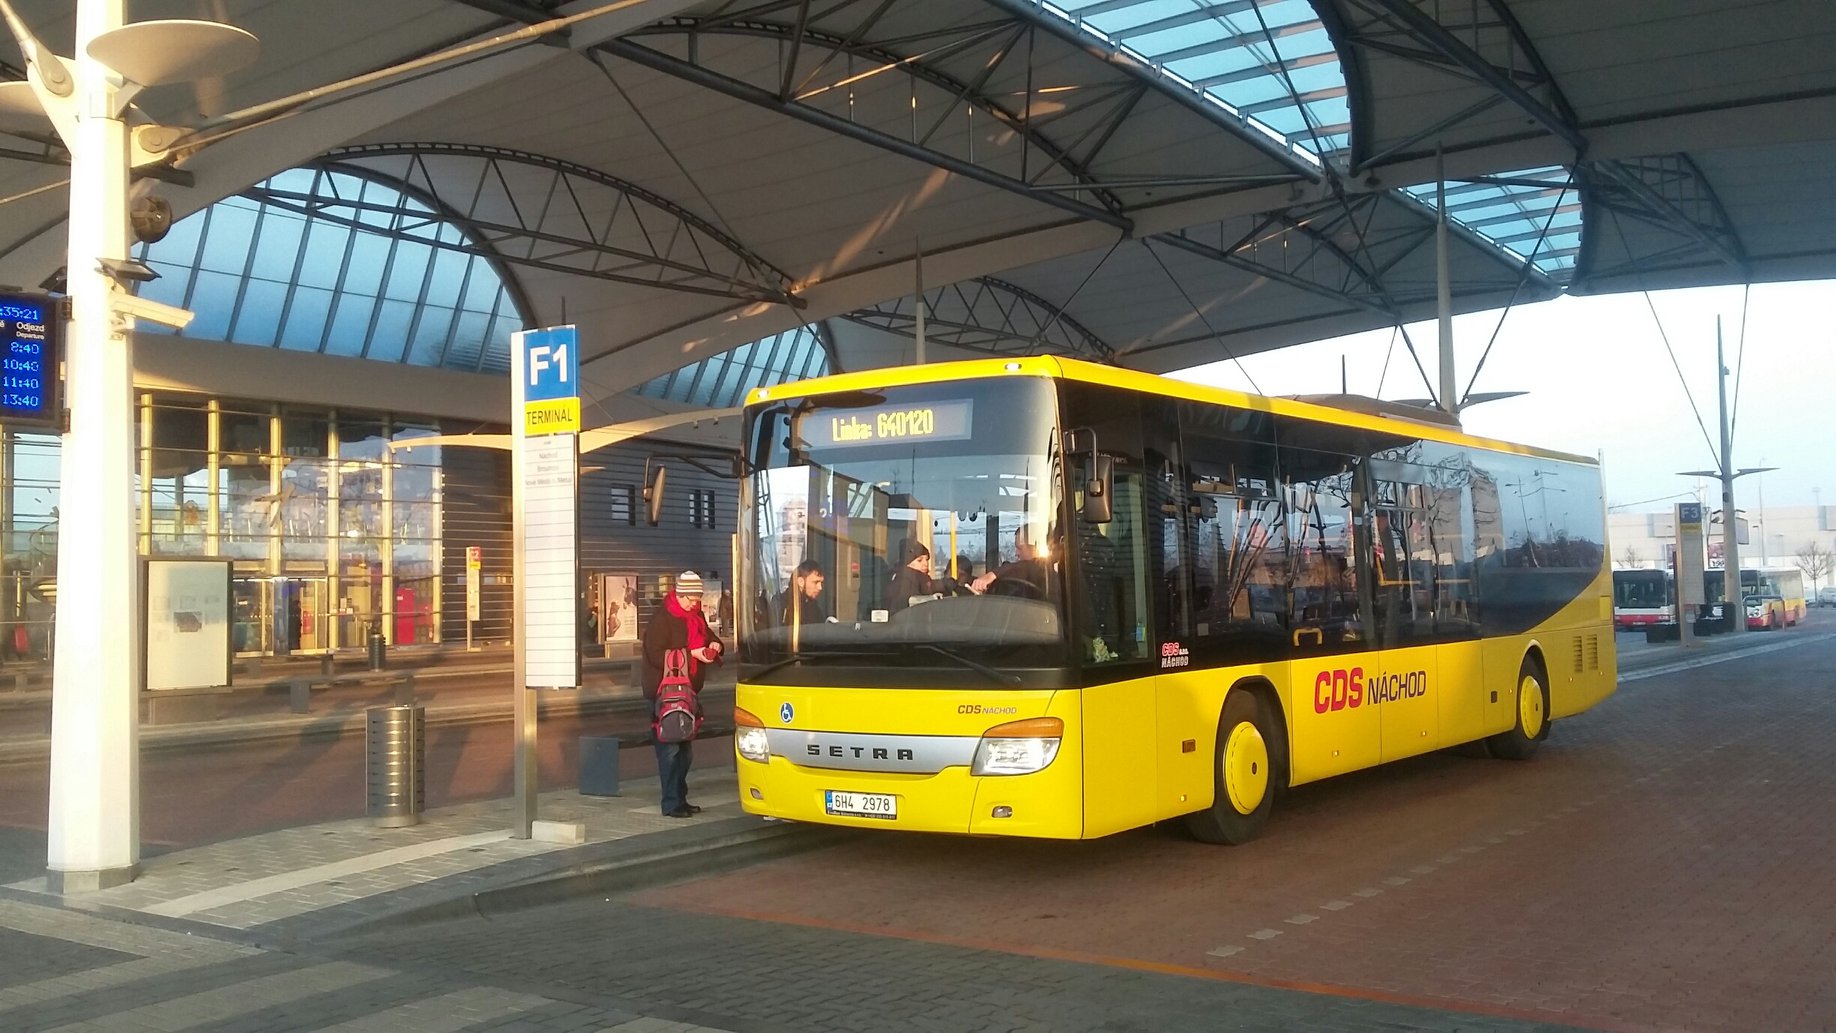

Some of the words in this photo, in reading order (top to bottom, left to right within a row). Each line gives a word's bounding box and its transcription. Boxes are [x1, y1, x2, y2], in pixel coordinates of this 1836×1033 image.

[16, 321, 45, 333] Odjezd
[11, 342, 39, 354] 8:40
[3, 359, 39, 372] 10:40
[530, 344, 567, 386] F1
[3, 376, 39, 389] 11:40
[3, 394, 38, 407] 13:40
[877, 409, 934, 438] 640120
[1681, 507, 1699, 519] F3
[1162, 642, 1179, 656] CDS
[1161, 656, 1189, 668] NÁCHOD
[1314, 666, 1364, 714] CDS
[1367, 671, 1426, 705] NÁCHOD
[957, 705, 981, 714] CDS
[807, 744, 914, 761] SETRA
[835, 794, 854, 809] 6H4
[862, 797, 890, 811] 2978
